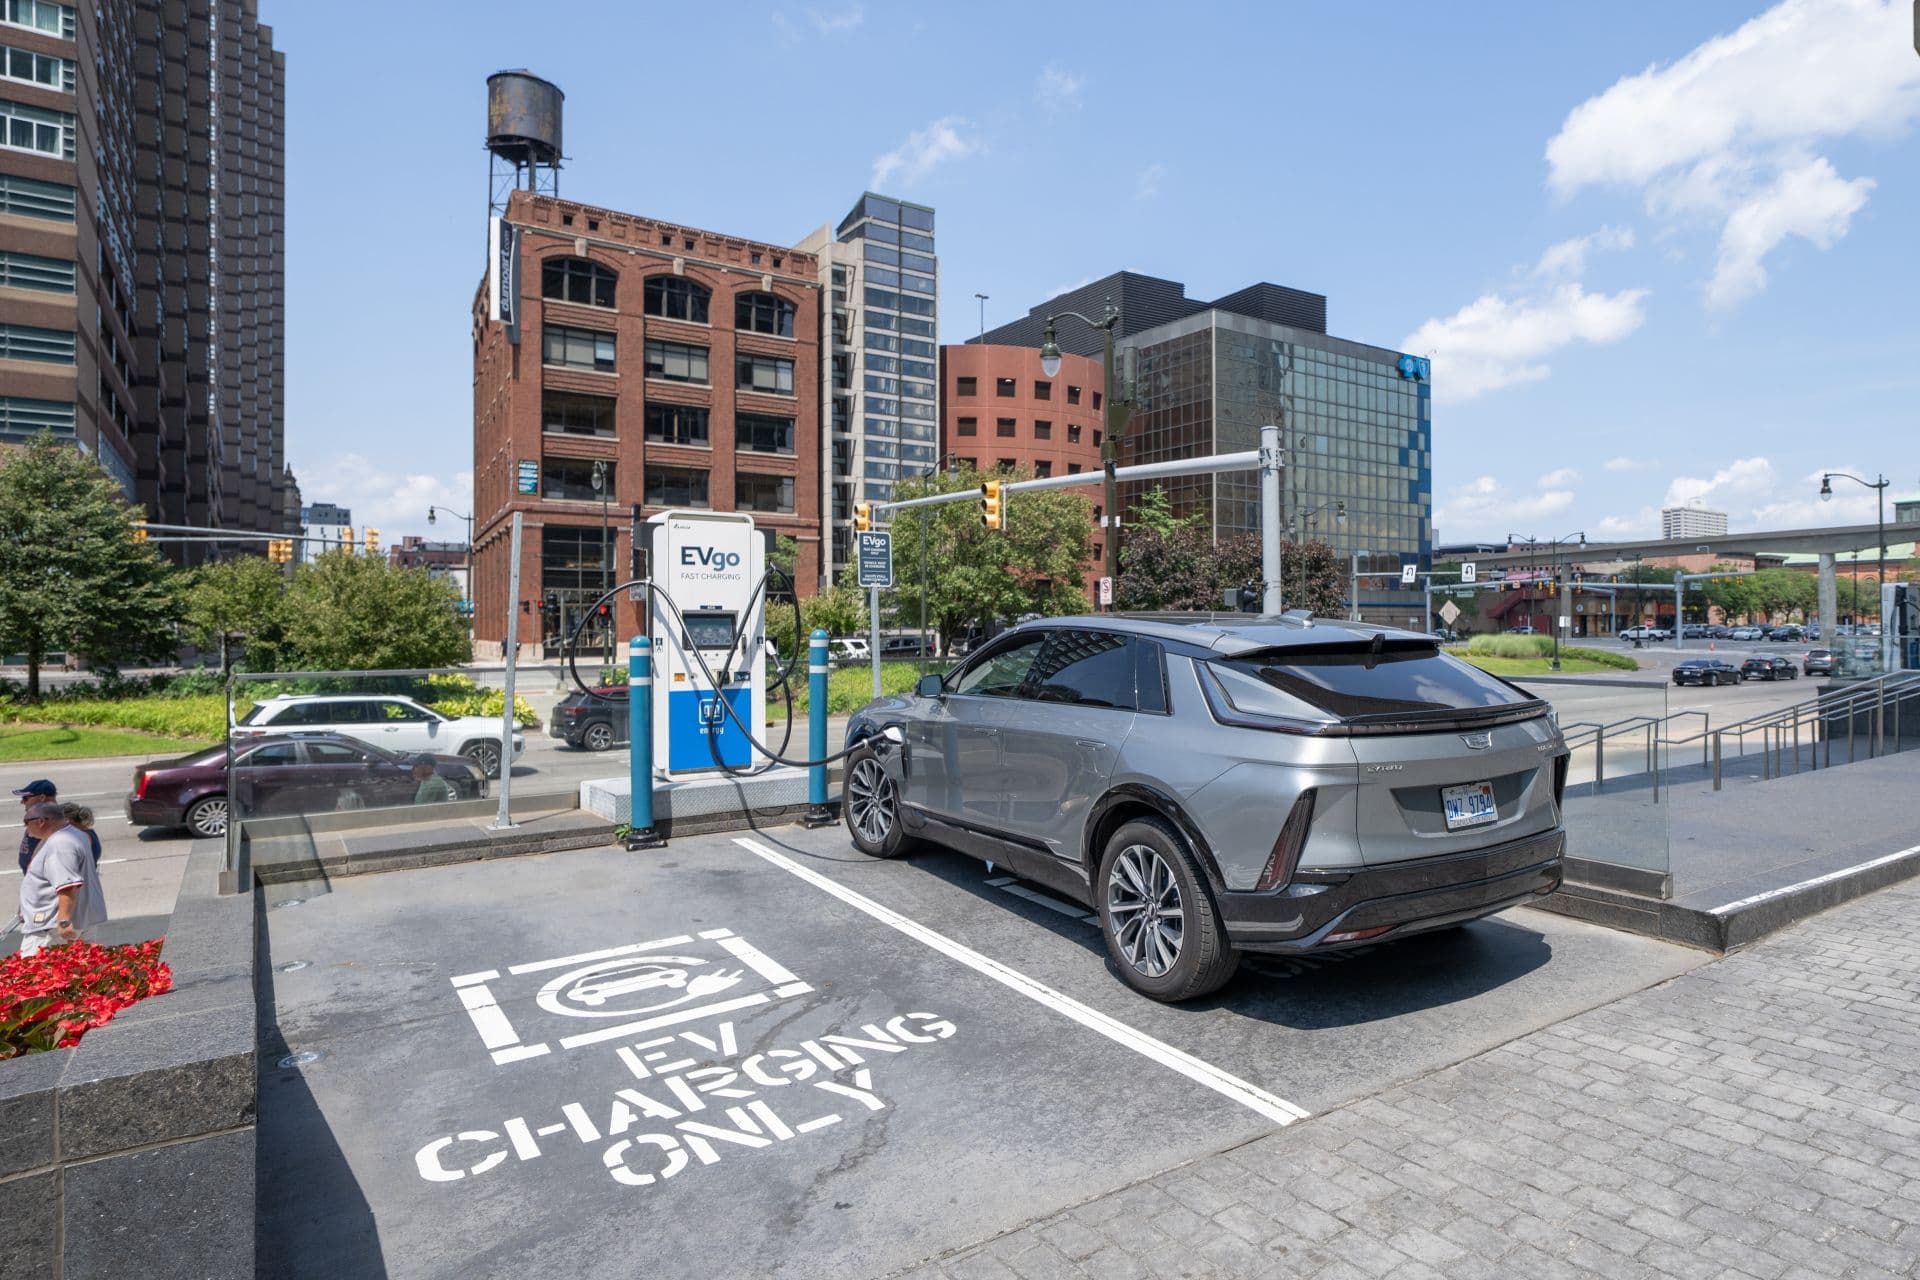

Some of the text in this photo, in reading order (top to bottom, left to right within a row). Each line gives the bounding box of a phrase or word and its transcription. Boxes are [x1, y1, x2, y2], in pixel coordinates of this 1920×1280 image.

[681, 546, 740, 571] EVgo
[863, 536, 886, 547] EVgo
[700, 727, 723, 735] enrgy
[616, 1021, 739, 1079] EV
[415, 1012, 957, 1182] CHARGING
[602, 1068, 886, 1186] ONLY
